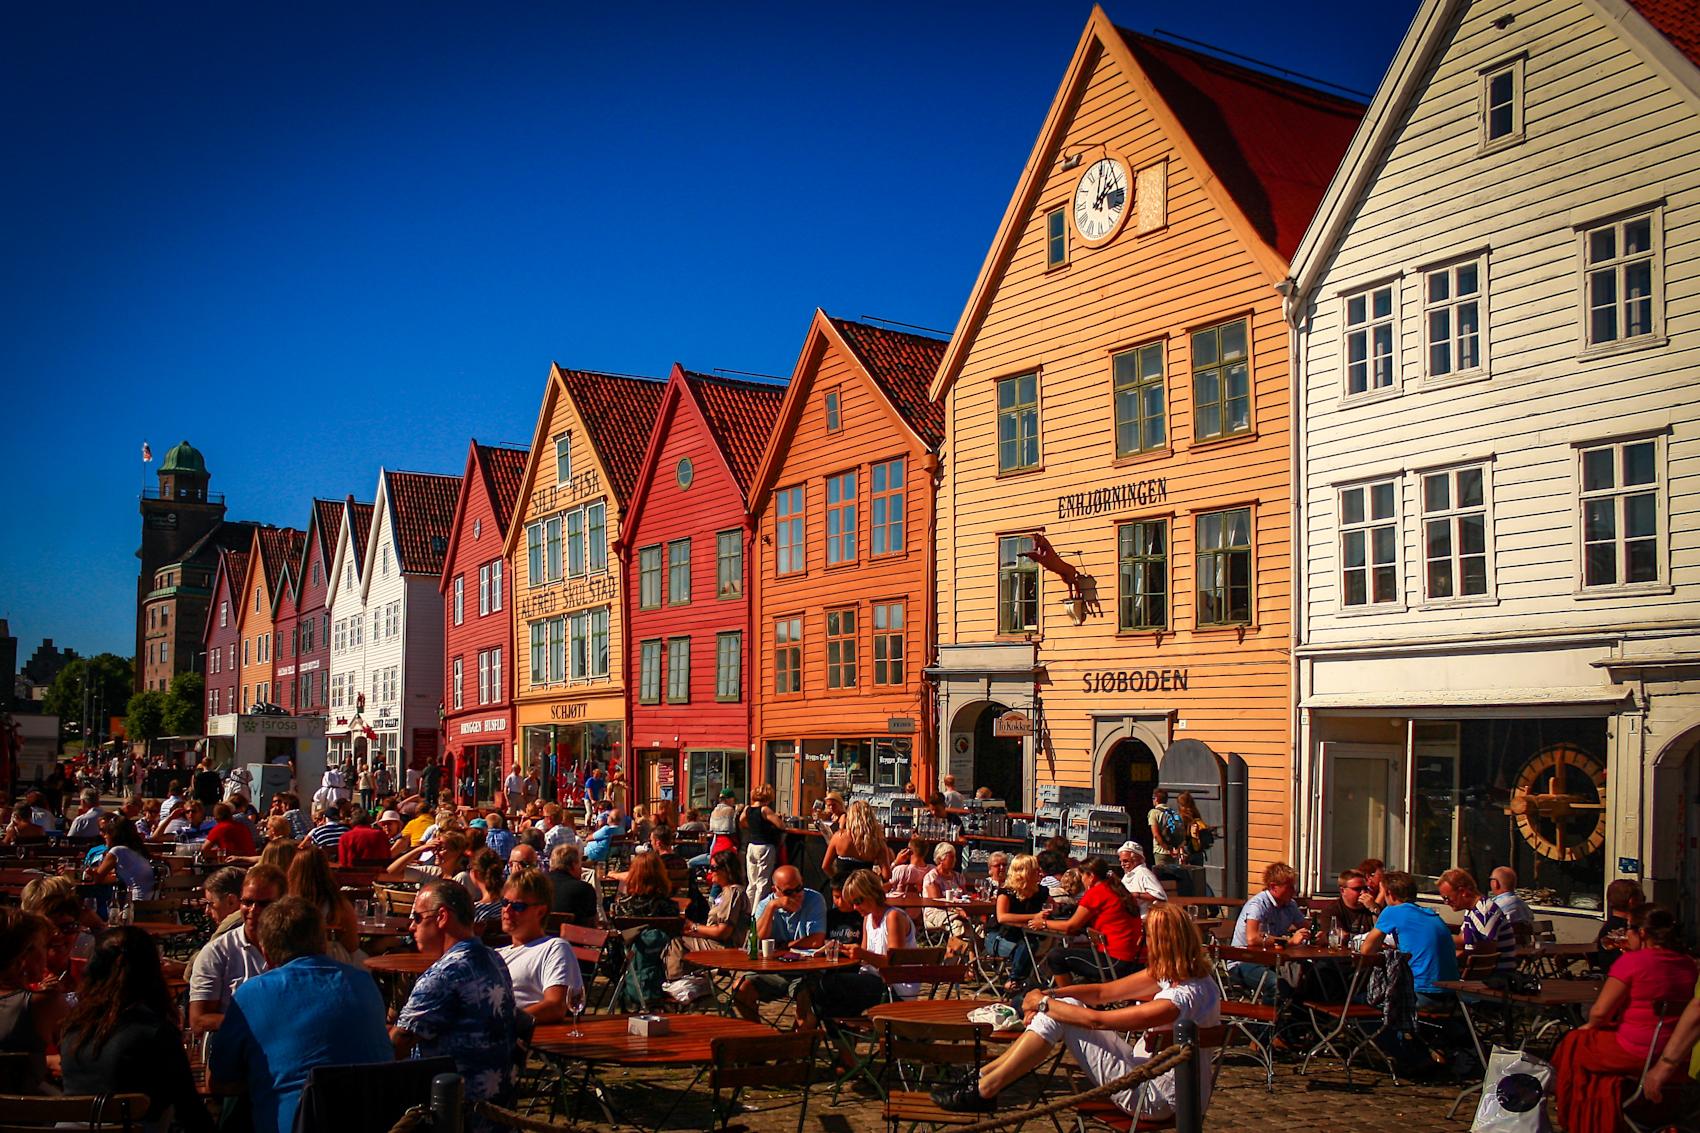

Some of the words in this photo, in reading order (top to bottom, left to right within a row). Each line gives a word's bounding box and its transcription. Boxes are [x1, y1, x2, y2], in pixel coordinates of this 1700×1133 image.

[531, 485, 557, 516] SILD
[570, 468, 600, 501] FISK
[1058, 477, 1167, 519] ENHJØRNINGEN
[521, 590, 556, 619] ALFRED
[1083, 669, 1188, 693] SJØBODEN
[551, 703, 587, 720] SCHJØTT
